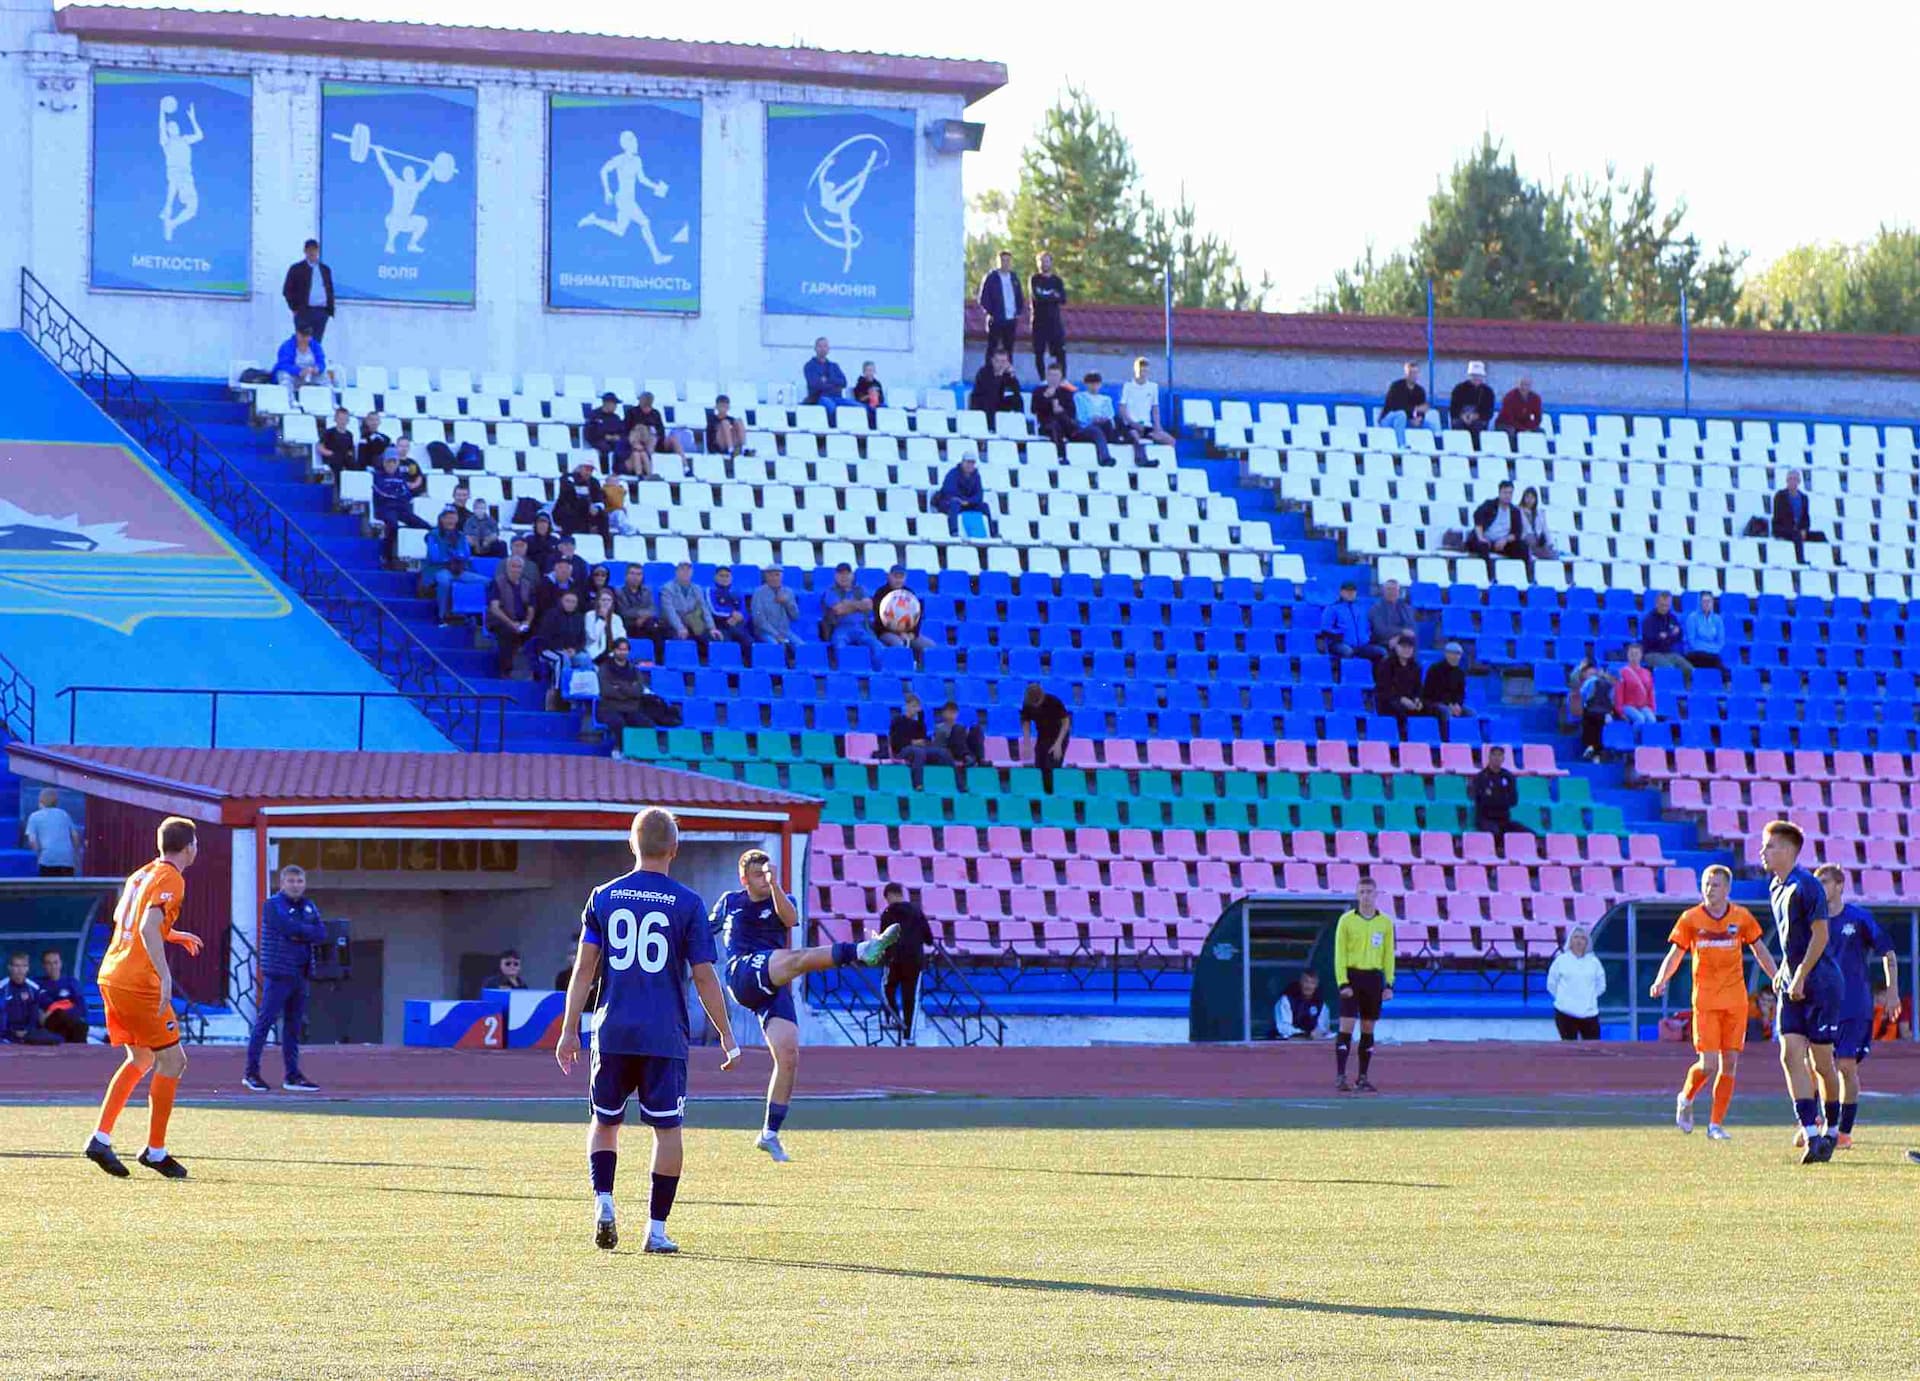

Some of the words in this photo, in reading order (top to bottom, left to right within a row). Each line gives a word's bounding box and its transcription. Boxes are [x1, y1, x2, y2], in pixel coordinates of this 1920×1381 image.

[132, 254, 211, 272] МЕТКОСТЬ
[378, 264, 418, 280] ВОЛЯ
[559, 272, 692, 291] ВНИМАТЕЛЬНОСТЬ
[801, 281, 877, 298] ГАРМОНИЯ
[608, 908, 670, 973] 96
[484, 1016, 498, 1045] 2
